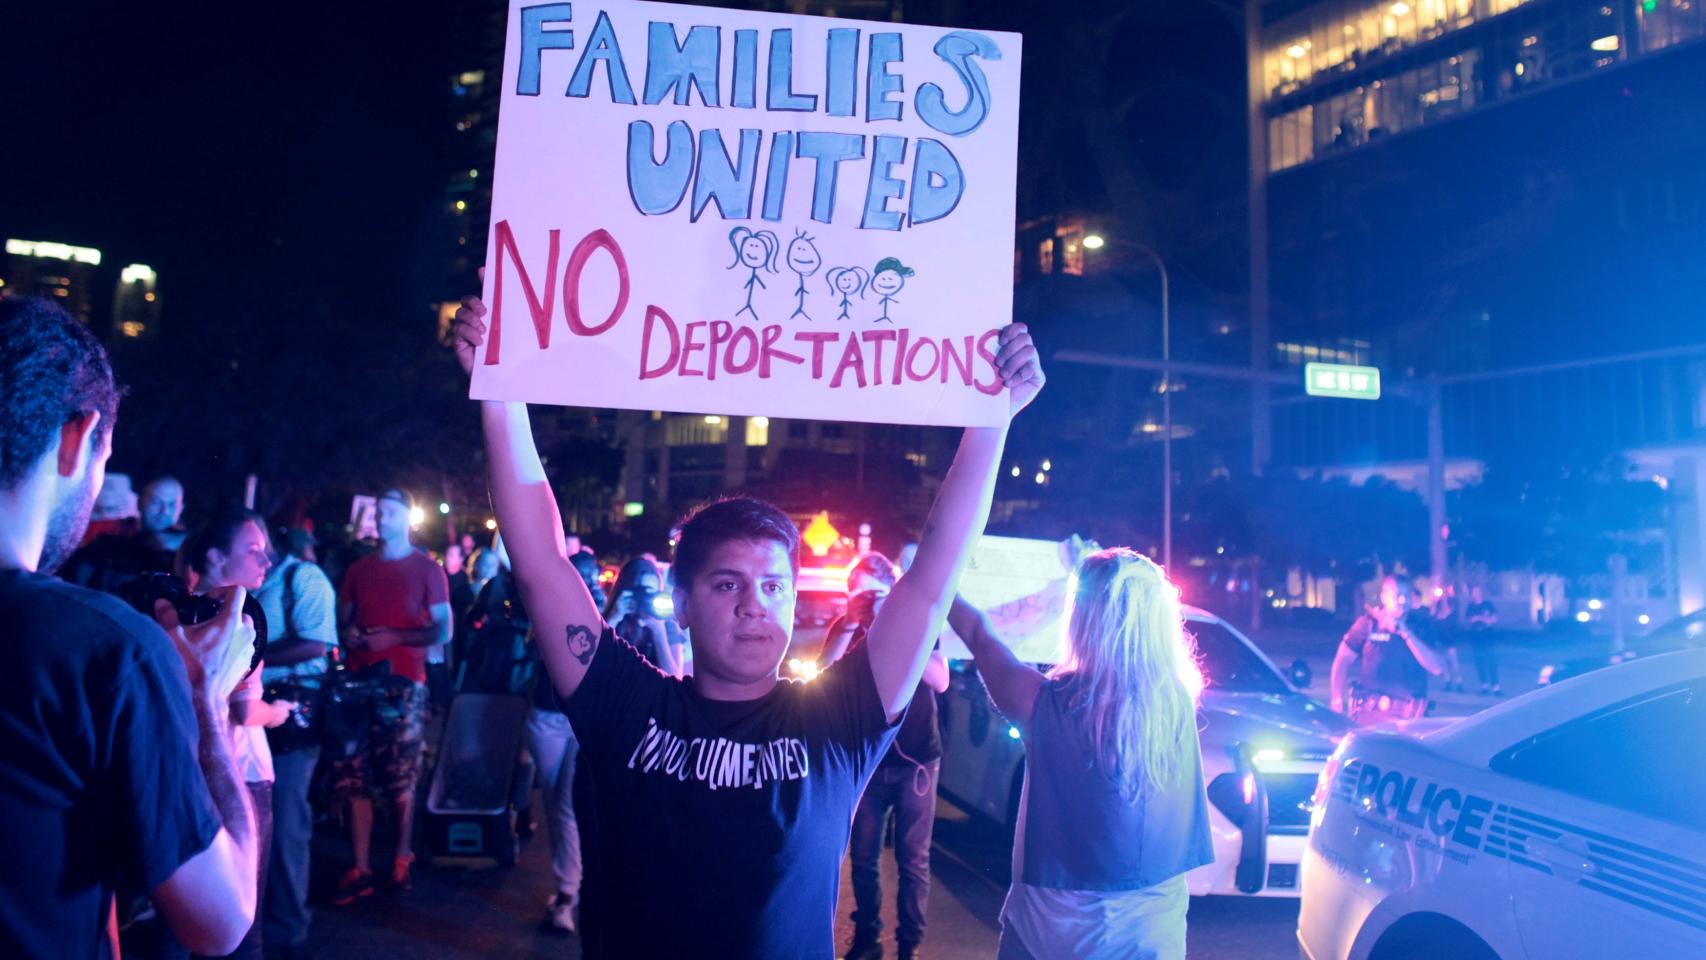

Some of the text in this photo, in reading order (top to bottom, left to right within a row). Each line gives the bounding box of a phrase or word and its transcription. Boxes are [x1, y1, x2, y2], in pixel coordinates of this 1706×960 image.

[516, 2, 1002, 137] FAMILIES
[627, 120, 966, 231] UNITED
[484, 219, 1004, 396] NO DEPORTATIONS
[1357, 764, 1494, 850] POLICE
